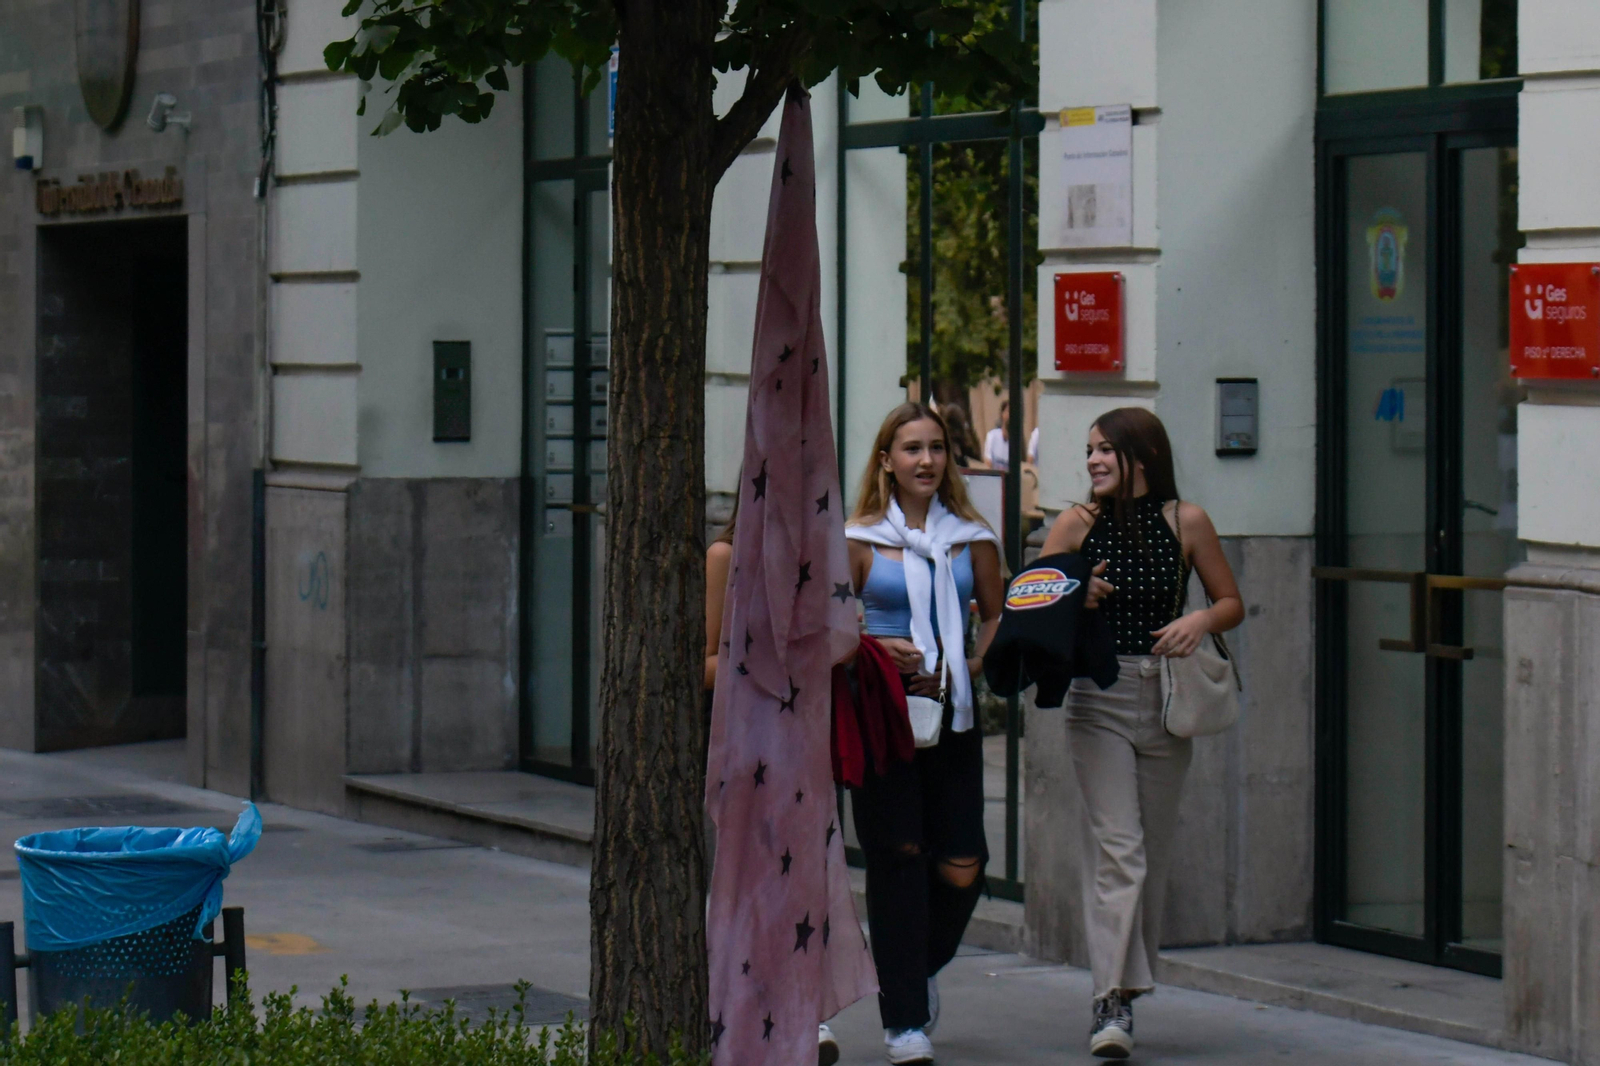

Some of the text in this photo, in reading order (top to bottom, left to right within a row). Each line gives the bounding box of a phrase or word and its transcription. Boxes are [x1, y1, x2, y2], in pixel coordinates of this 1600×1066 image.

[1080, 290, 1096, 306] Ges
[1545, 284, 1567, 302] Ges
[1080, 308, 1110, 325] seguros
[1546, 305, 1587, 325] seguros
[1524, 346, 1541, 358] PISO
